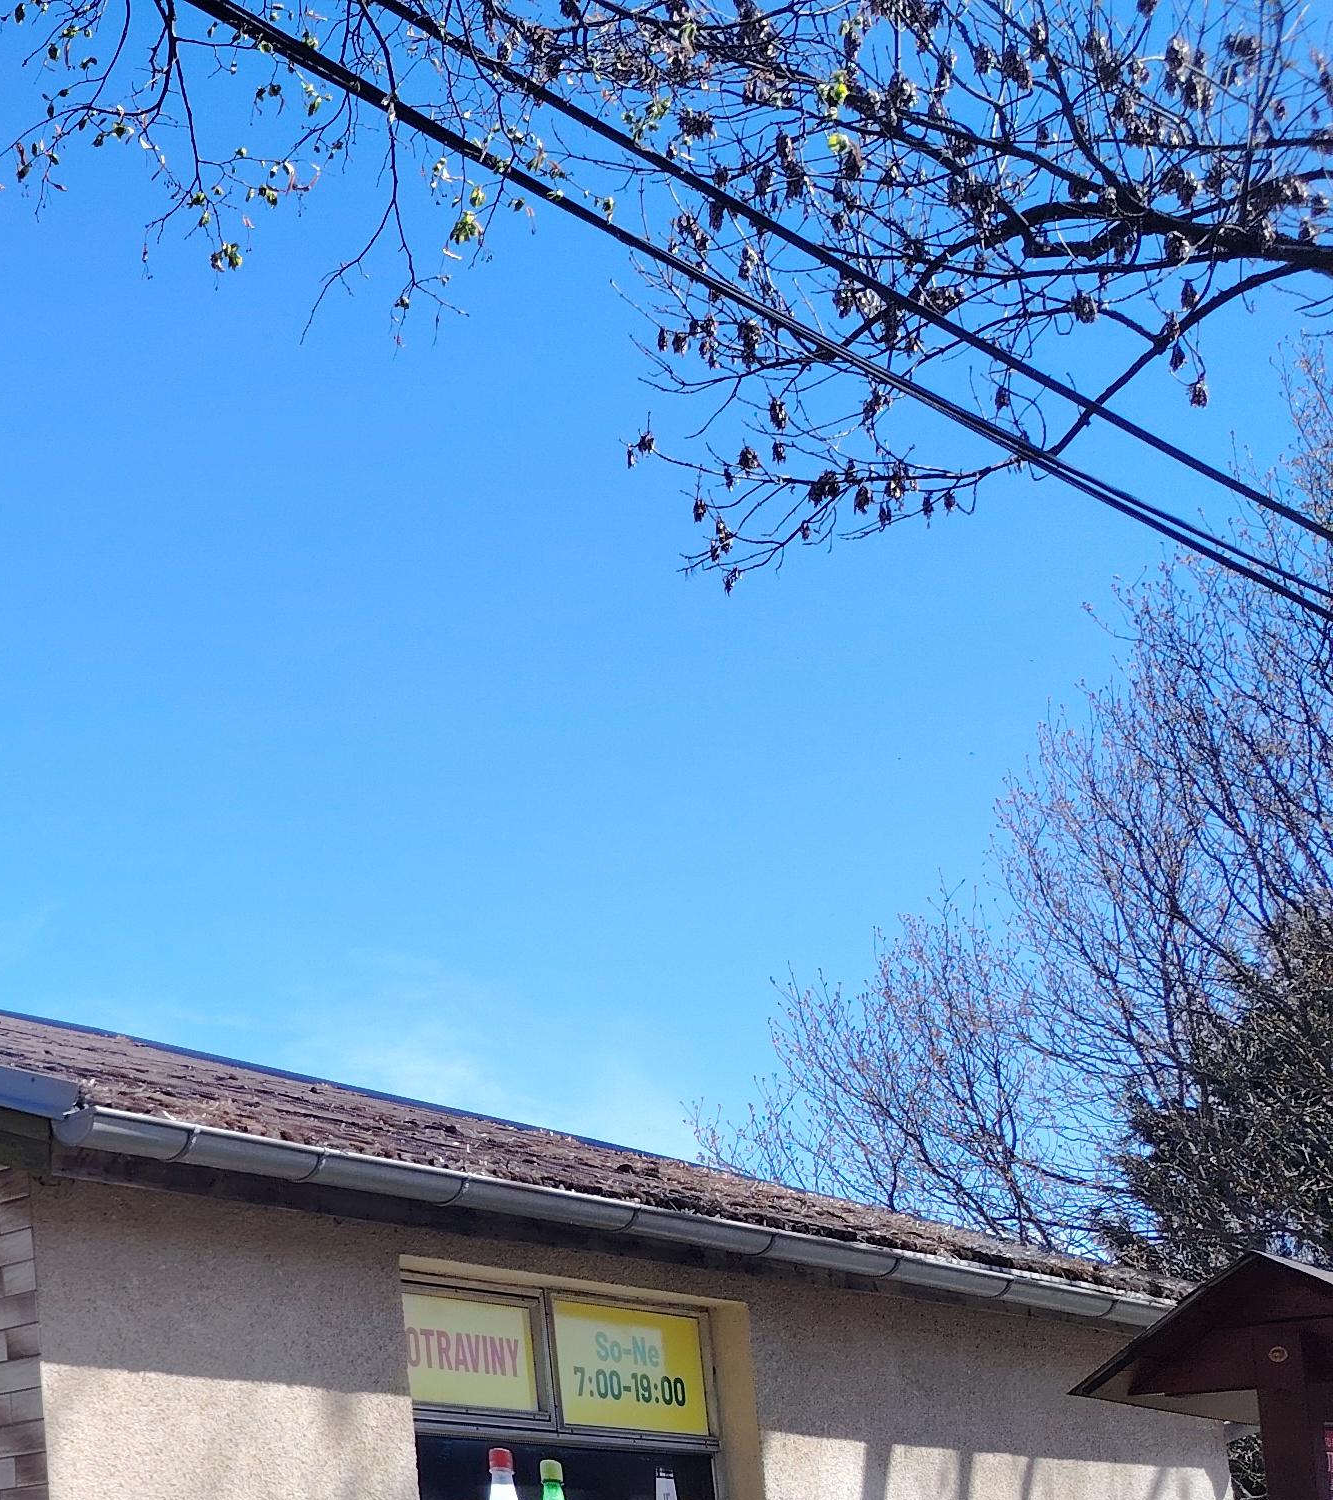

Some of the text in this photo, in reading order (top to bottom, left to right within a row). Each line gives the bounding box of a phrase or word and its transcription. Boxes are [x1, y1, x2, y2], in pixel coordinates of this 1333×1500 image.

[405, 1326, 519, 1378] OTRAVINY
[594, 1330, 662, 1368] So-Ne
[572, 1366, 686, 1407] 7:00-19:00
